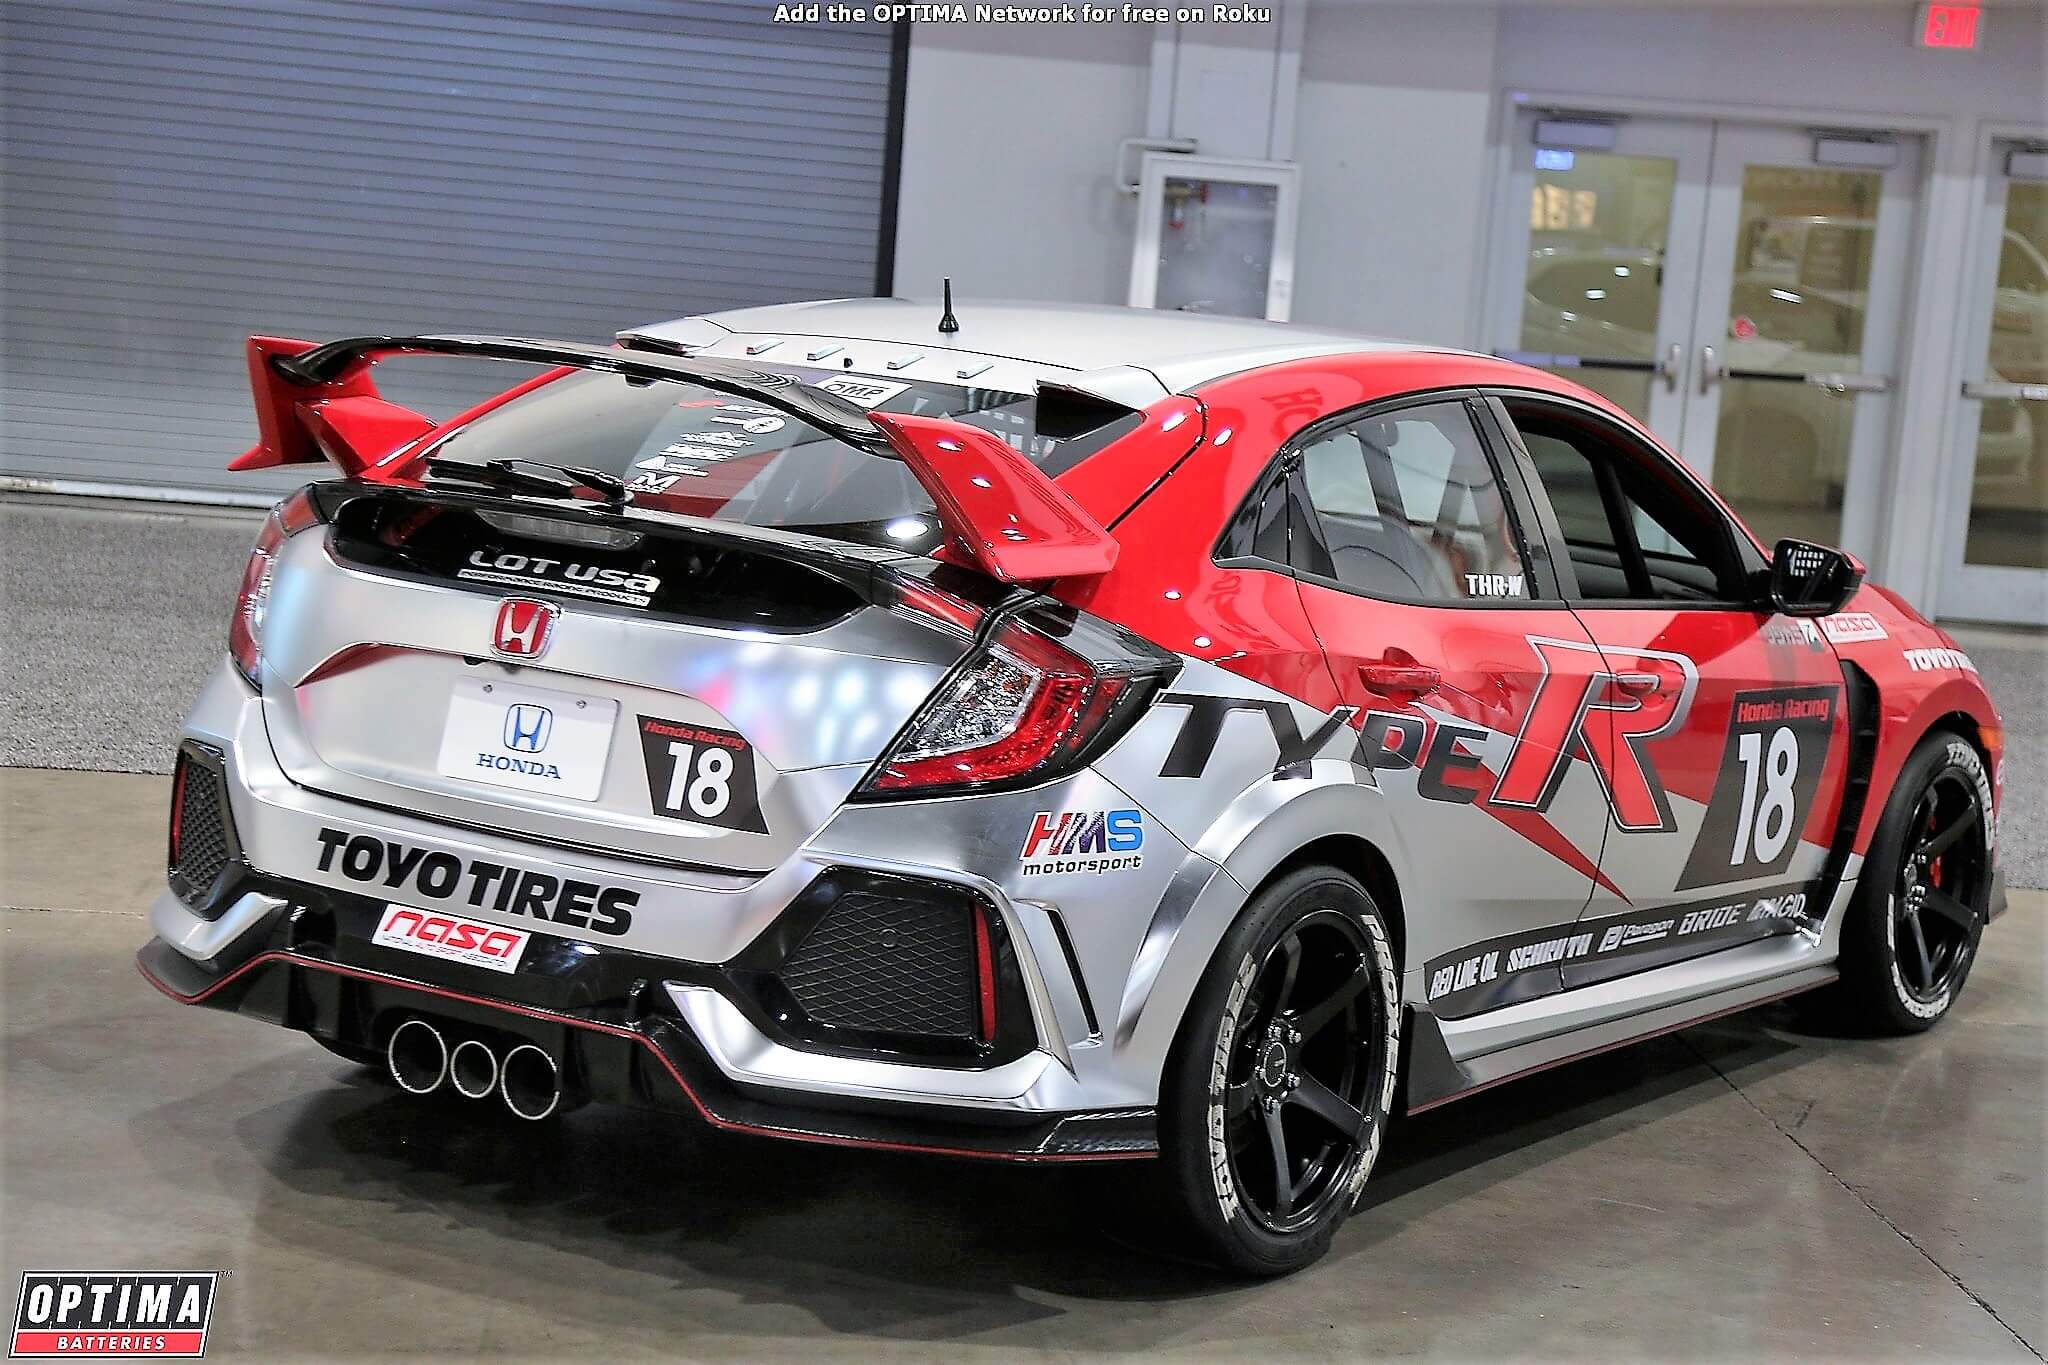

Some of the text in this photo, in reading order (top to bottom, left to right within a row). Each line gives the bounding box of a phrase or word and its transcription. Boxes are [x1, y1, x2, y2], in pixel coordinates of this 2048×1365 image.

[824, 383, 884, 397] OMP
[469, 550, 560, 574] LOT
[1737, 699, 1830, 723] Honda Racing
[644, 720, 746, 751] Honda Racing
[1151, 634, 1700, 834] TYPE R
[476, 752, 562, 779] HONDA
[665, 741, 734, 818] 18
[1730, 725, 1800, 865] 18
[1022, 809, 1143, 859] HMS
[317, 827, 642, 937] TOYO TIRES
[1023, 855, 1142, 876] motorsport
[1678, 903, 1747, 936] BRIDE
[1428, 951, 1500, 1001] RED LINE OIL
